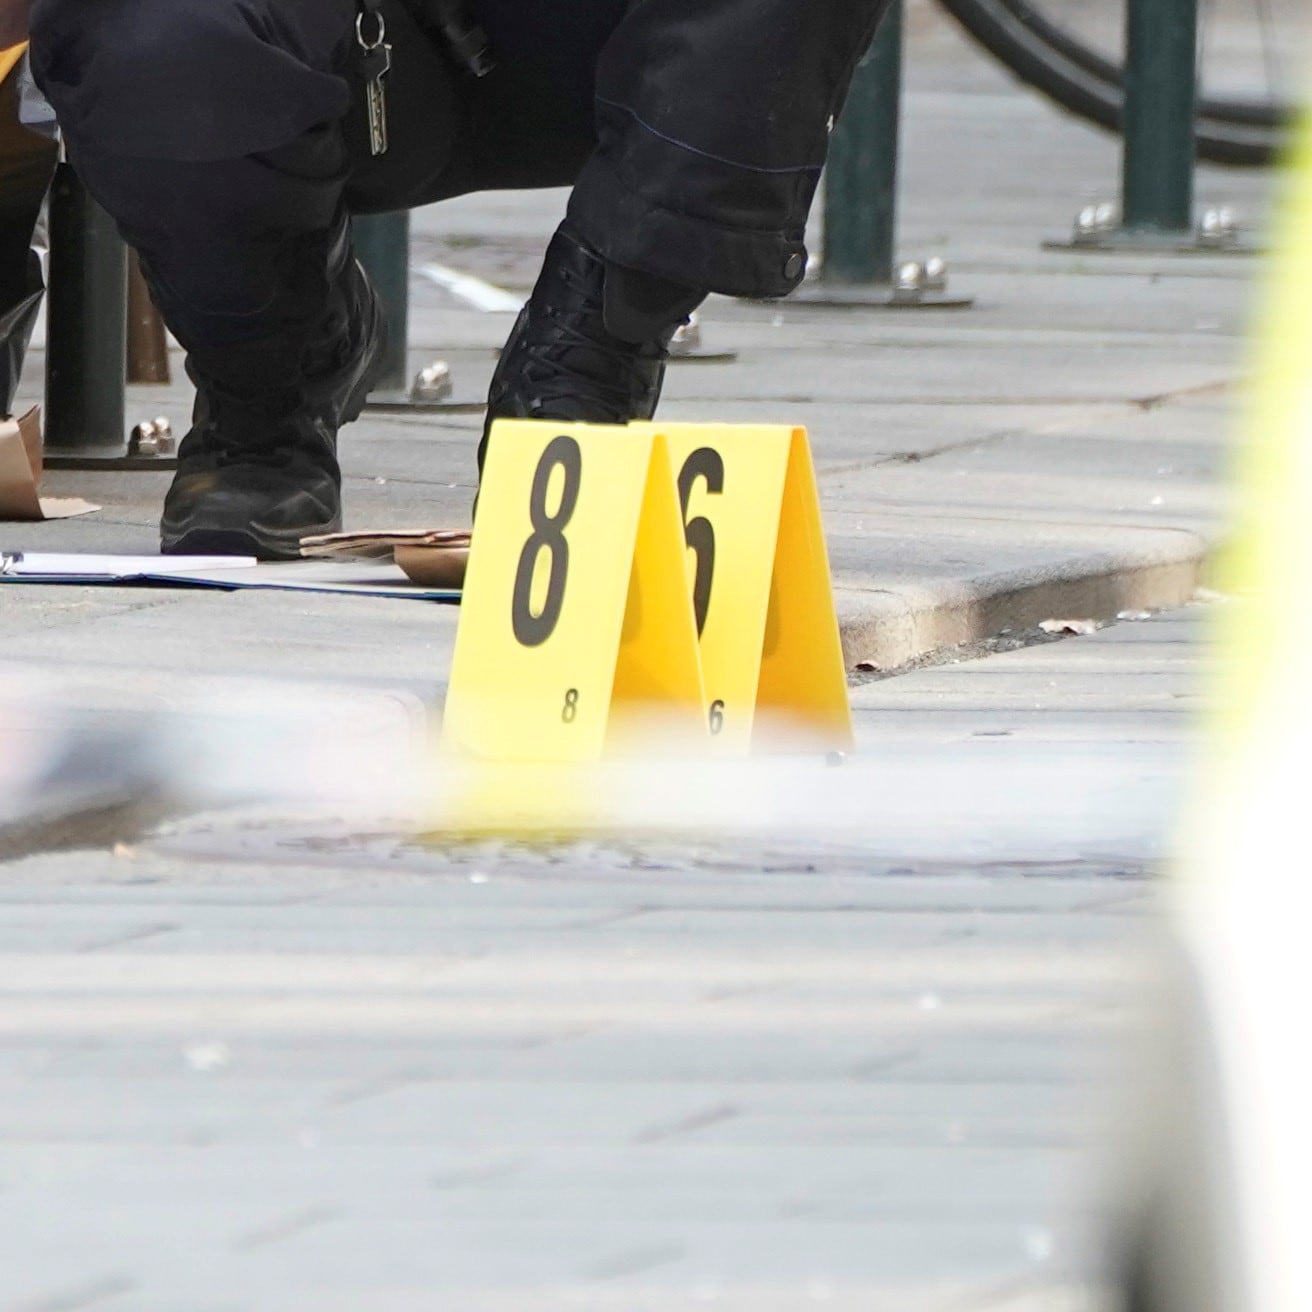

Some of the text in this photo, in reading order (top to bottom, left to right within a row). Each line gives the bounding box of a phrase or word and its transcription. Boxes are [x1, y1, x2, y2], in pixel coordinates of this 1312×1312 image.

[511, 435, 582, 647] 8
[677, 446, 725, 640] 6
[561, 688, 579, 724] 8
[709, 699, 724, 735] 6
